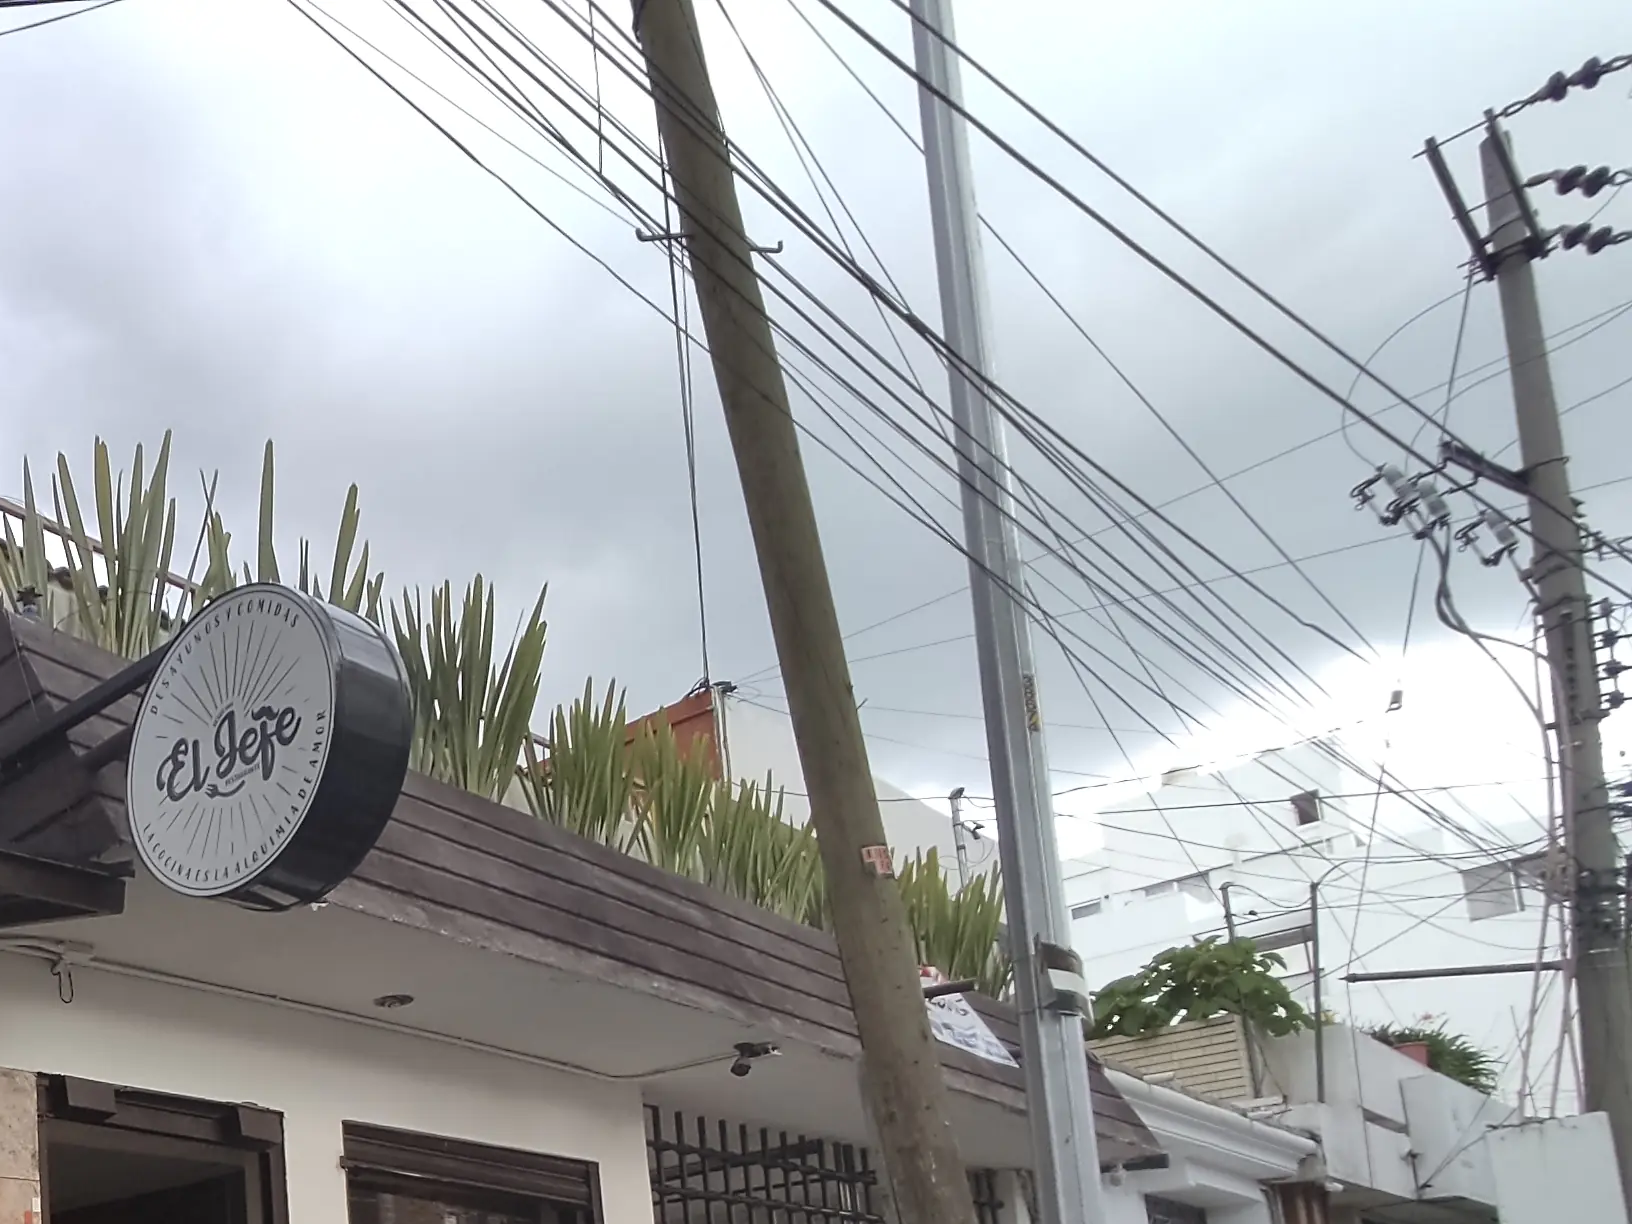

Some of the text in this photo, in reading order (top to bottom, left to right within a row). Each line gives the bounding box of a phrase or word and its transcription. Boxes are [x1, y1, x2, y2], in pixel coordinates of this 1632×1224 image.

[150, 615, 220, 715] DESAYUNOS
[226, 607, 232, 622] Y
[237, 599, 299, 628] COMIDAS
[143, 709, 326, 882] LA COCINA ES LA ALQUIMIA DE AMOR
[156, 706, 302, 802] El Jefe
